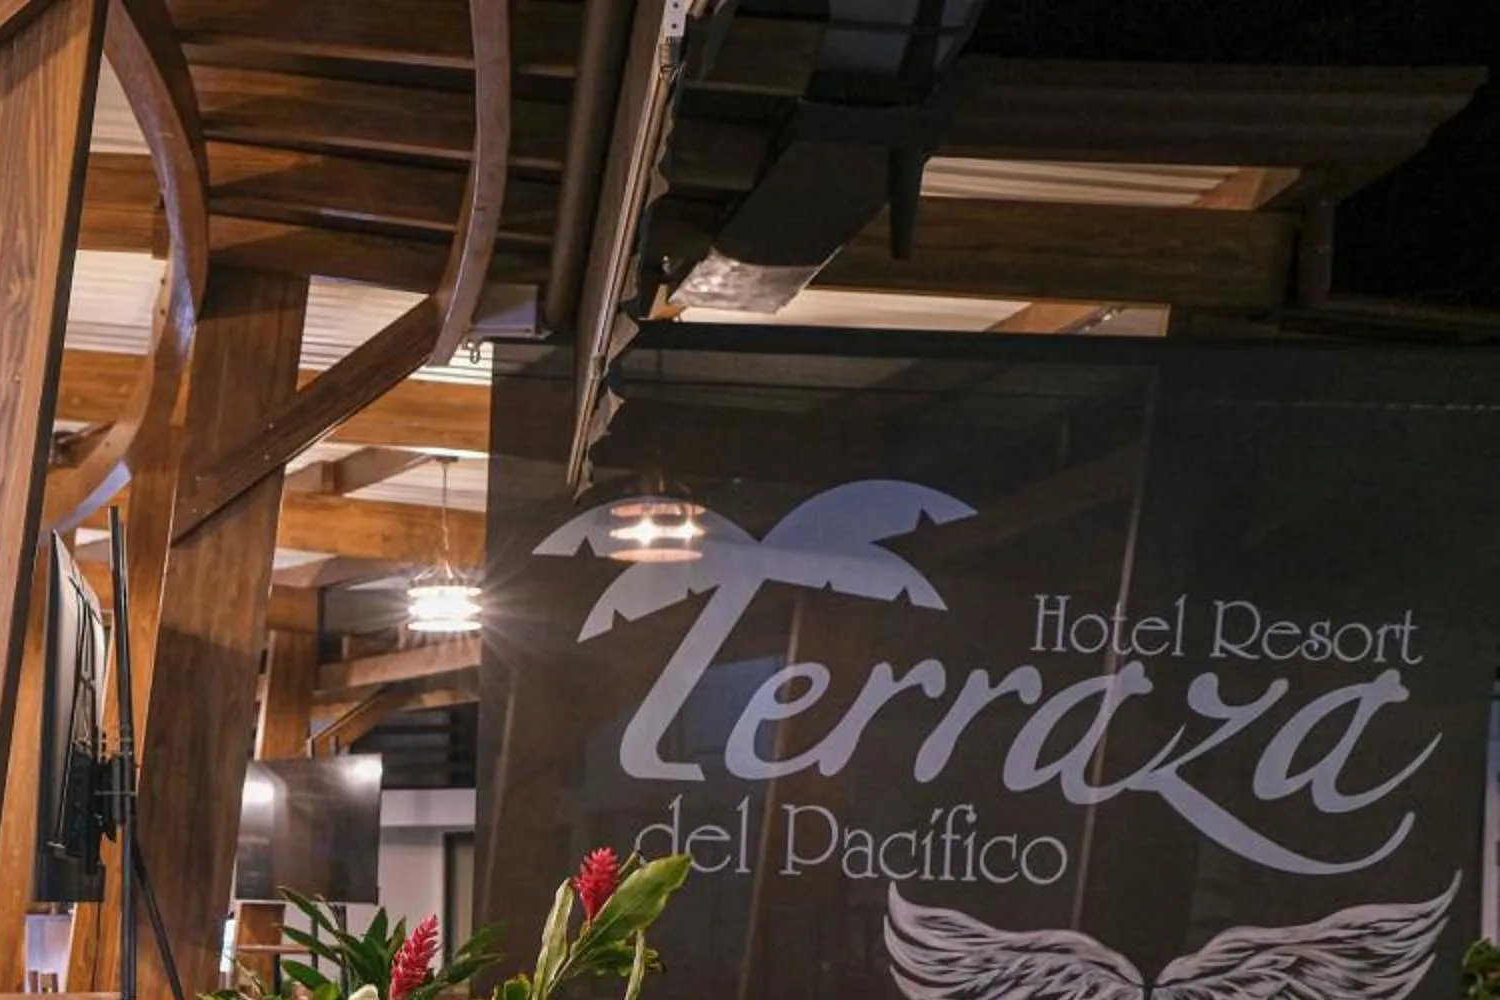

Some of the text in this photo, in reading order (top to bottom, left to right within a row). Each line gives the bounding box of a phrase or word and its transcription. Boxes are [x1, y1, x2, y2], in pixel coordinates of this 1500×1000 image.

[1029, 594, 1424, 665] Hotel Resort
[533, 479, 1443, 875] Terraza
[634, 794, 1069, 885] del Pacífico
